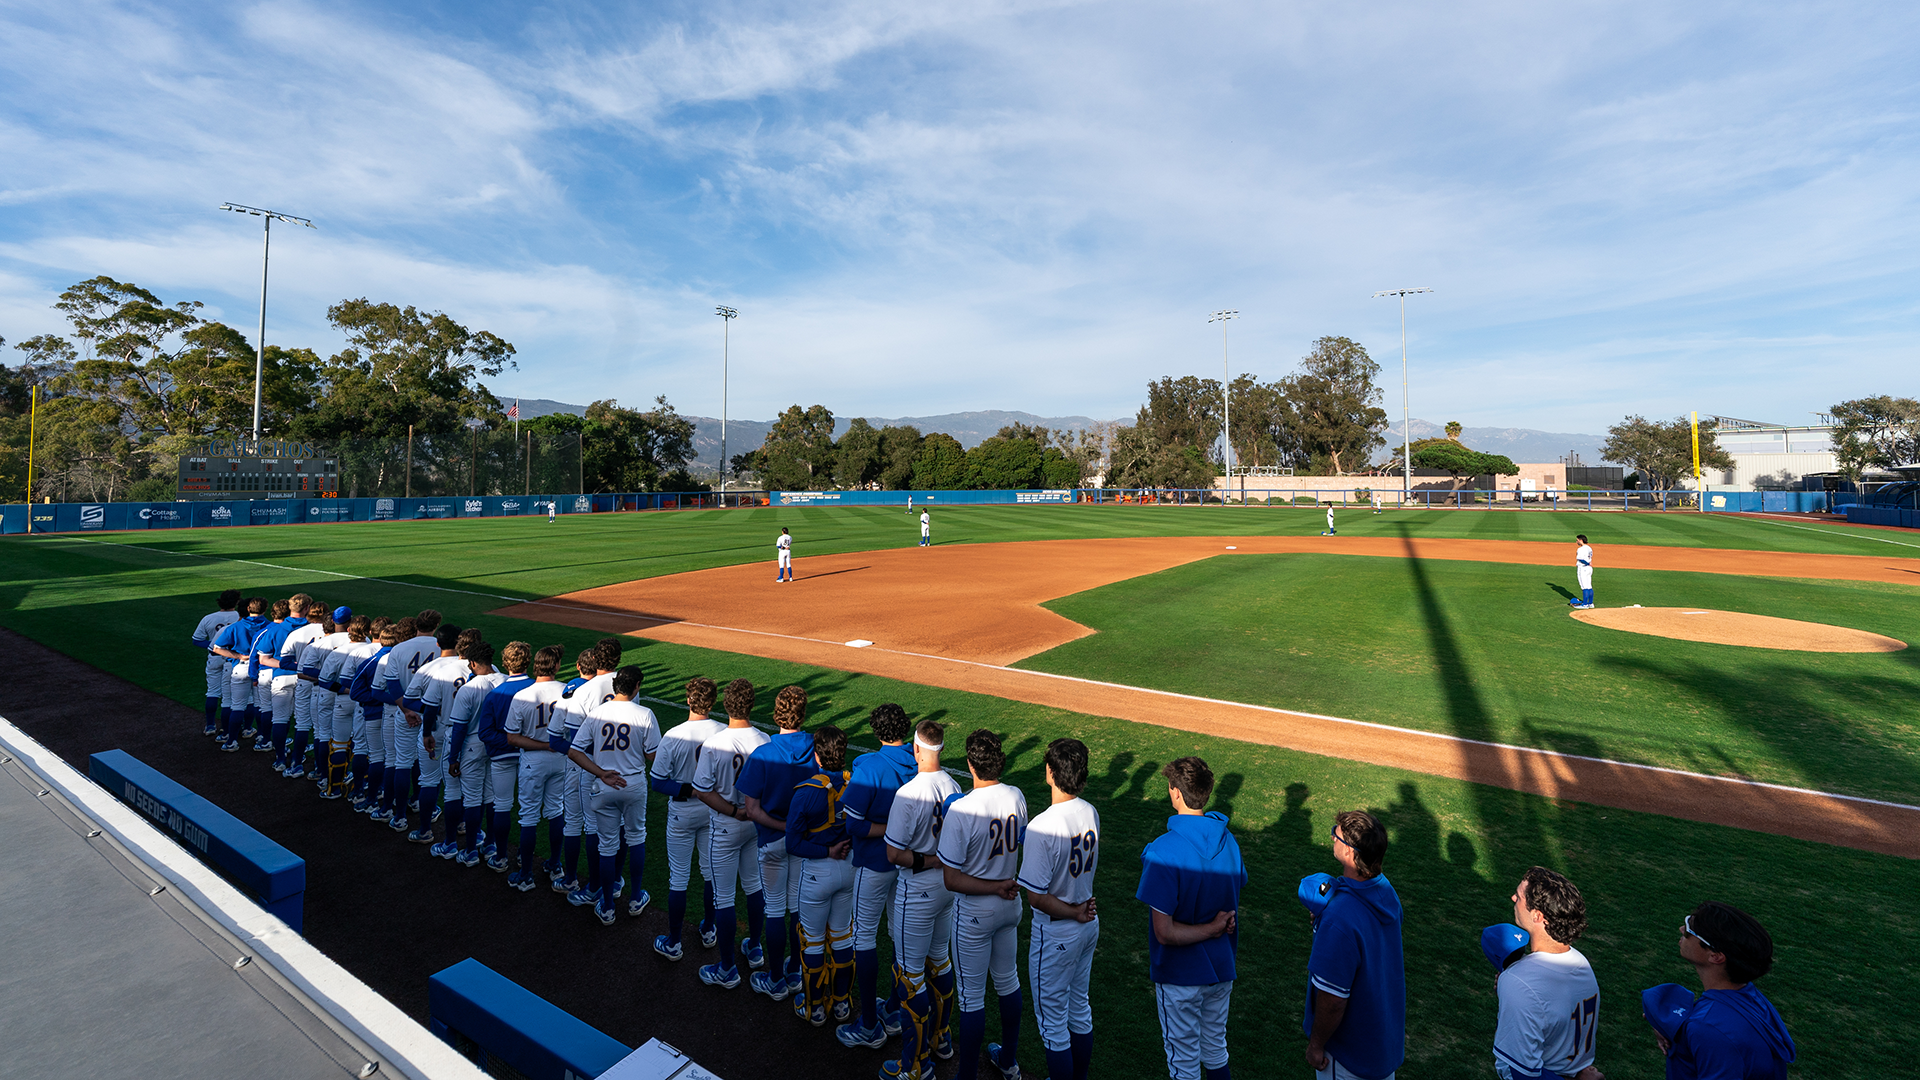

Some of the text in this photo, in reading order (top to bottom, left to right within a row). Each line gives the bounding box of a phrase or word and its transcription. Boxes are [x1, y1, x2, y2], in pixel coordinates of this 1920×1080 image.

[209, 439, 314, 459] GAUCHOS
[600, 722, 630, 752] 28
[124, 781, 208, 854] NO SEEDS NO GUM
[988, 814, 1018, 860] 20
[1069, 829, 1096, 878] 52
[1566, 993, 1598, 1062] 17
